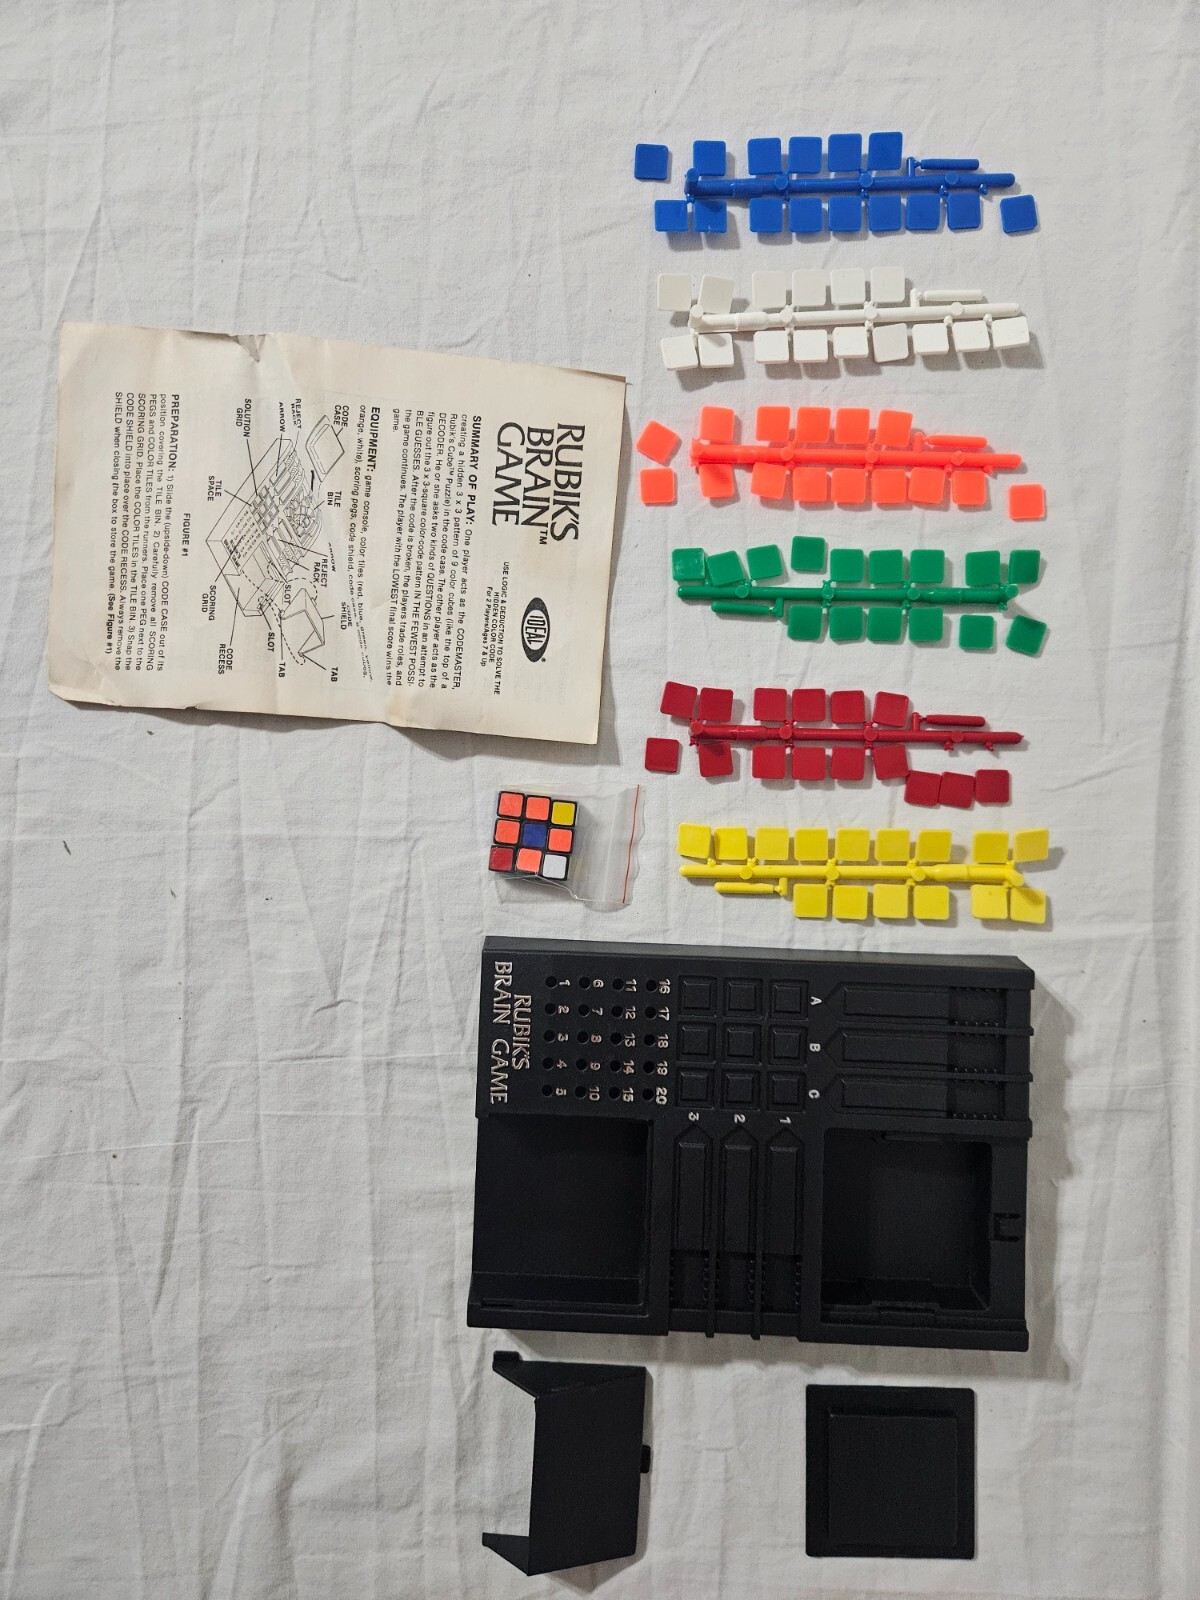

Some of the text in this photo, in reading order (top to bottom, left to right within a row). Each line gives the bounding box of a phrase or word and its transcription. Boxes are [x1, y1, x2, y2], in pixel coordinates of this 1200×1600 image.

[115, 392, 123, 424] SHIELD
[243, 398, 252, 437] SOLUTION
[333, 405, 341, 425] CASE
[341, 405, 349, 427] CODE
[168, 394, 179, 471] PREPARATION:
[436, 413, 447, 456] DECODER.
[449, 414, 458, 443] Rubik's
[458, 414, 467, 447] creating
[367, 407, 380, 472] EQUIPMENT:
[469, 415, 482, 470] SUMMARY
[111, 451, 120, 480] closing
[435, 460, 443, 471] He
[457, 460, 465, 487] hidden
[492, 422, 525, 526] GAME
[435, 473, 440, 482] or
[468, 474, 477, 490] OF
[550, 423, 585, 541] RUBIK'S
[207, 476, 215, 501] SPACE
[334, 491, 342, 507] TILE
[443, 478, 453, 506] Puzzle)
[111, 516, 117, 524] to
[360, 501, 370, 533] console,
[466, 495, 476, 524] PLAY:
[182, 513, 190, 556] FIGURE #1
[442, 519, 450, 532] the
[359, 537, 367, 557] color
[464, 529, 472, 546] One
[161, 523, 171, 578] (upside-down)
[429, 540, 438, 560] kinds
[452, 550, 459, 558] of
[357, 560, 365, 578] tiles
[428, 562, 435, 571] of
[461, 550, 470, 574] player
[437, 578, 446, 592] The
[449, 570, 457, 589] color
[107, 593, 116, 611] (See
[161, 581, 169, 605] CODE
[201, 593, 209, 613] GRID
[208, 585, 216, 621] SCORING
[283, 584, 291, 604] SLOT
[424, 573, 435, 620] QUESTIONS
[459, 598, 465, 607] as
[436, 594, 444, 615] other
[447, 593, 455, 615] cubes
[106, 614, 115, 639] Figure
[160, 608, 168, 632] CASE
[340, 602, 348, 630] SHIELD
[458, 612, 466, 624] the
[482, 604, 491, 644] Players/Ages
[497, 606, 506, 644] DEDUCTION
[422, 633, 428, 642] an
[433, 617, 442, 641] player
[445, 619, 454, 635] (like
[490, 619, 498, 642] COLOR
[524, 615, 547, 646] IDEAL
[105, 642, 113, 654] #1)
[267, 632, 275, 652] SLOT
[444, 639, 452, 651] the
[497, 646, 503, 655] TO
[158, 650, 165, 658] of
[218, 644, 226, 674] RECESS
[418, 645, 428, 676] attempt
[442, 655, 450, 668] top
[452, 628, 465, 689] CODEMASTER,
[480, 658, 487, 666] Up
[278, 662, 286, 677] TAB
[431, 663, 437, 673] as
[442, 672, 449, 680] of
[418, 679, 426, 687] to
[429, 675, 437, 688] the
[593, 979, 604, 987] 6
[558, 1006, 569, 1014] 2
[490, 962, 514, 1104] BRAIN GAME
[511, 994, 531, 1069] RUBIK'S
[623, 979, 636, 1102] 11 12 13 14 15
[656, 979, 670, 1104] 16 17 18 19 20
[809, 997, 822, 1098] A B C
[557, 1060, 567, 1068] 4
[590, 1087, 600, 1100] 10
[689, 1112, 699, 1121] 3
[734, 1114, 745, 1123] 2
